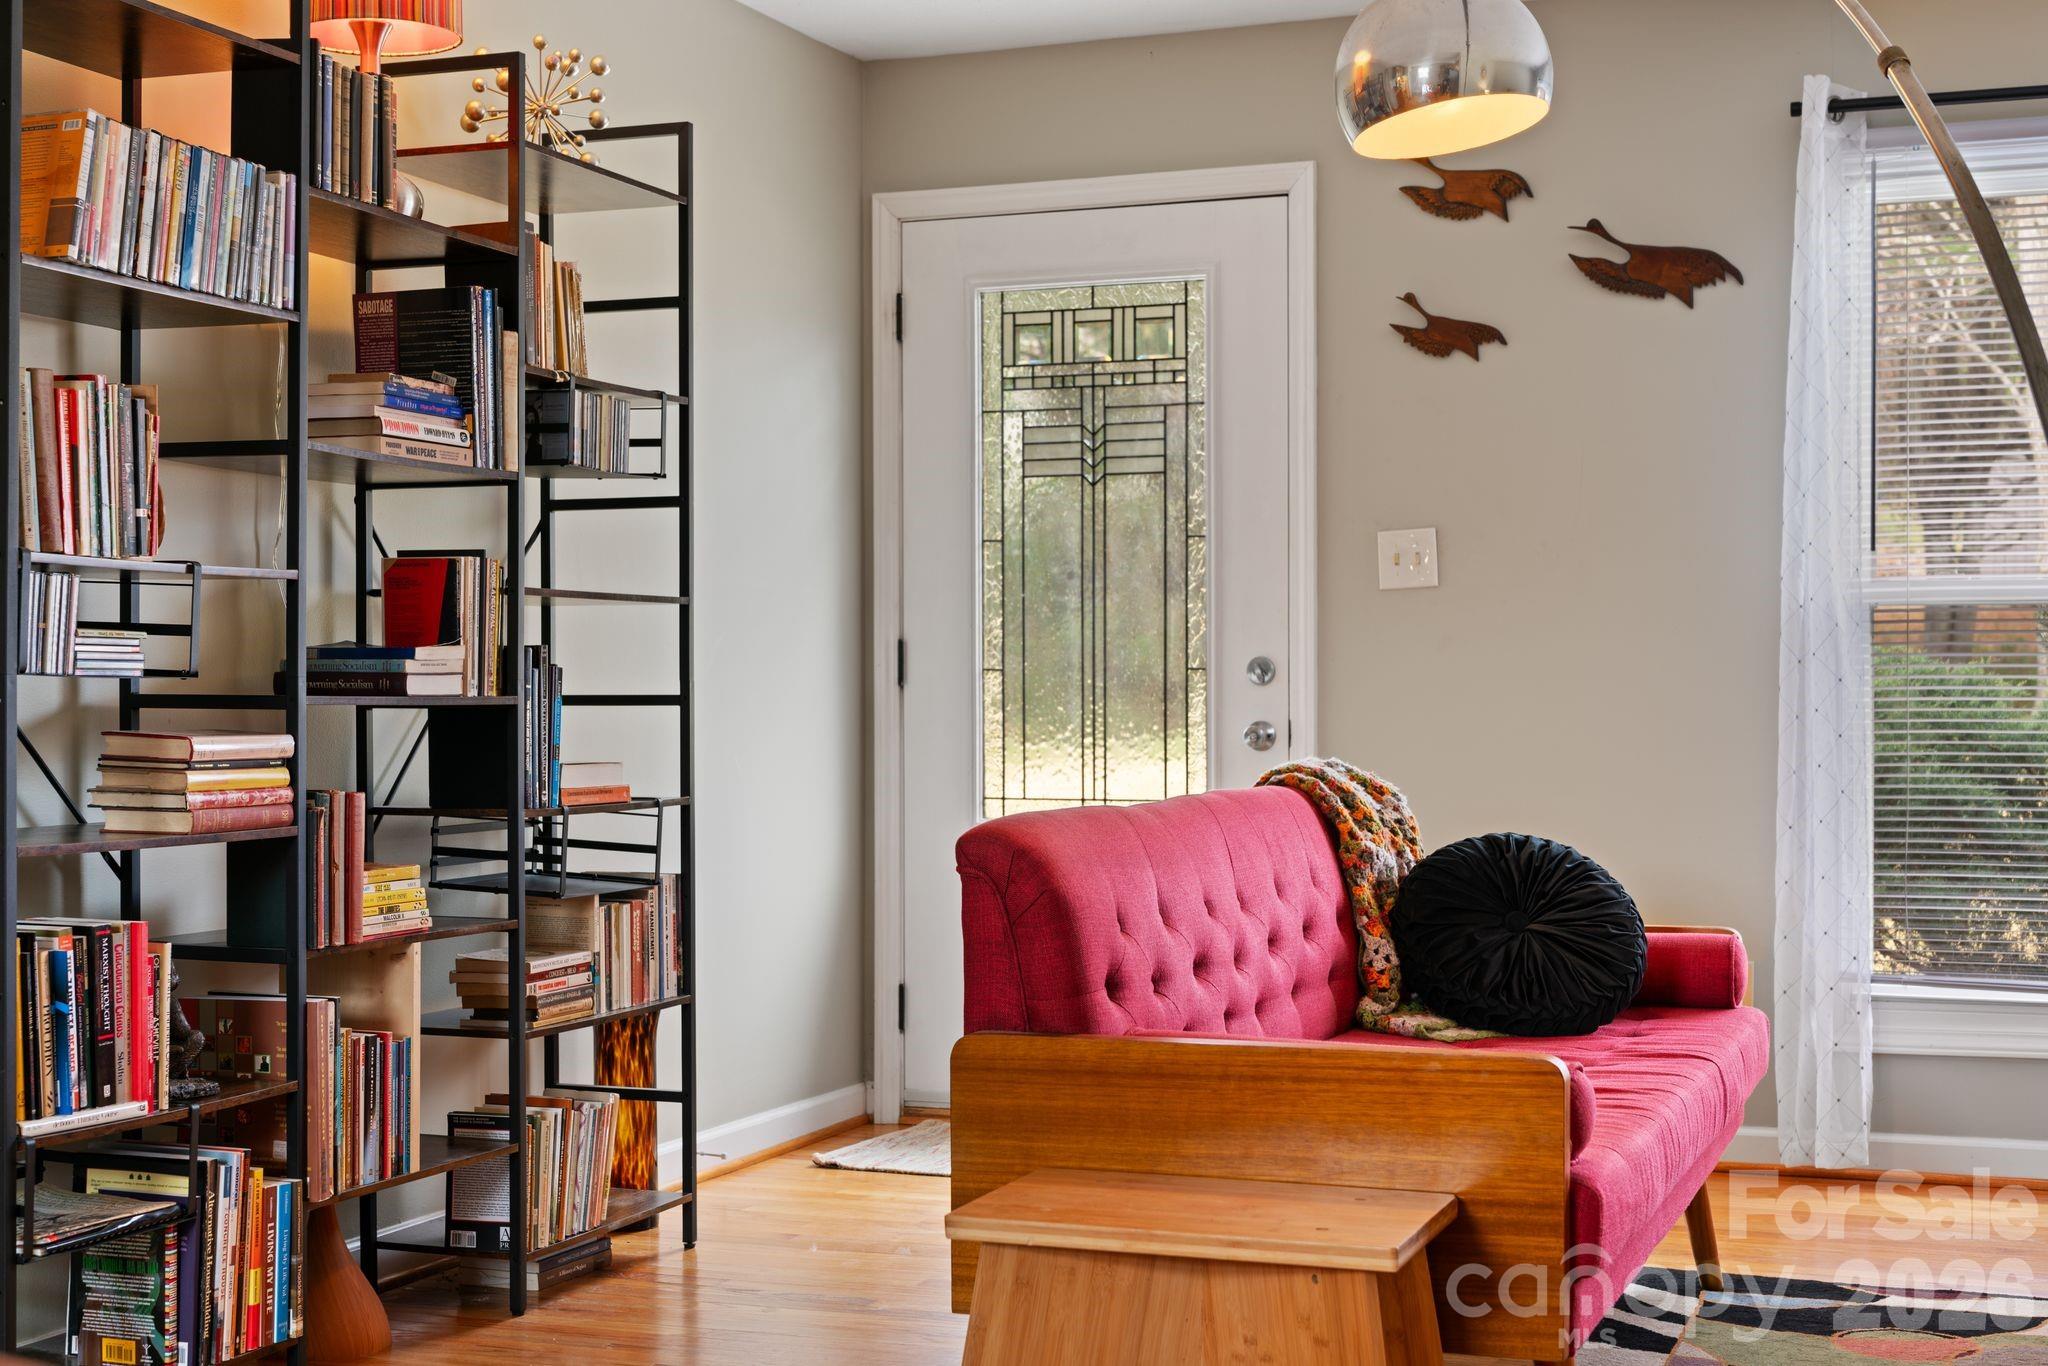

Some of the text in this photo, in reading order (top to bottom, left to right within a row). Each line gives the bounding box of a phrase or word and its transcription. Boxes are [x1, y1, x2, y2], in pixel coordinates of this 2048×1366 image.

[176, 160, 184, 191] POSTO
[358, 299, 393, 314] SABOTAGE
[406, 446, 418, 456] WAR
[420, 448, 437, 458] PEACE
[341, 660, 377, 670] Socialism
[339, 678, 374, 689] Socialism
[114, 944, 124, 1003] CALCULATED
[116, 1006, 125, 1038] CHAOS
[204, 1190, 215, 1339] Alternative Housebuilding
[282, 1254, 288, 1265] My
[169, 1260, 177, 1280] FIRST
[267, 1266, 274, 1284] MY
[169, 1280, 177, 1306] WORLD
